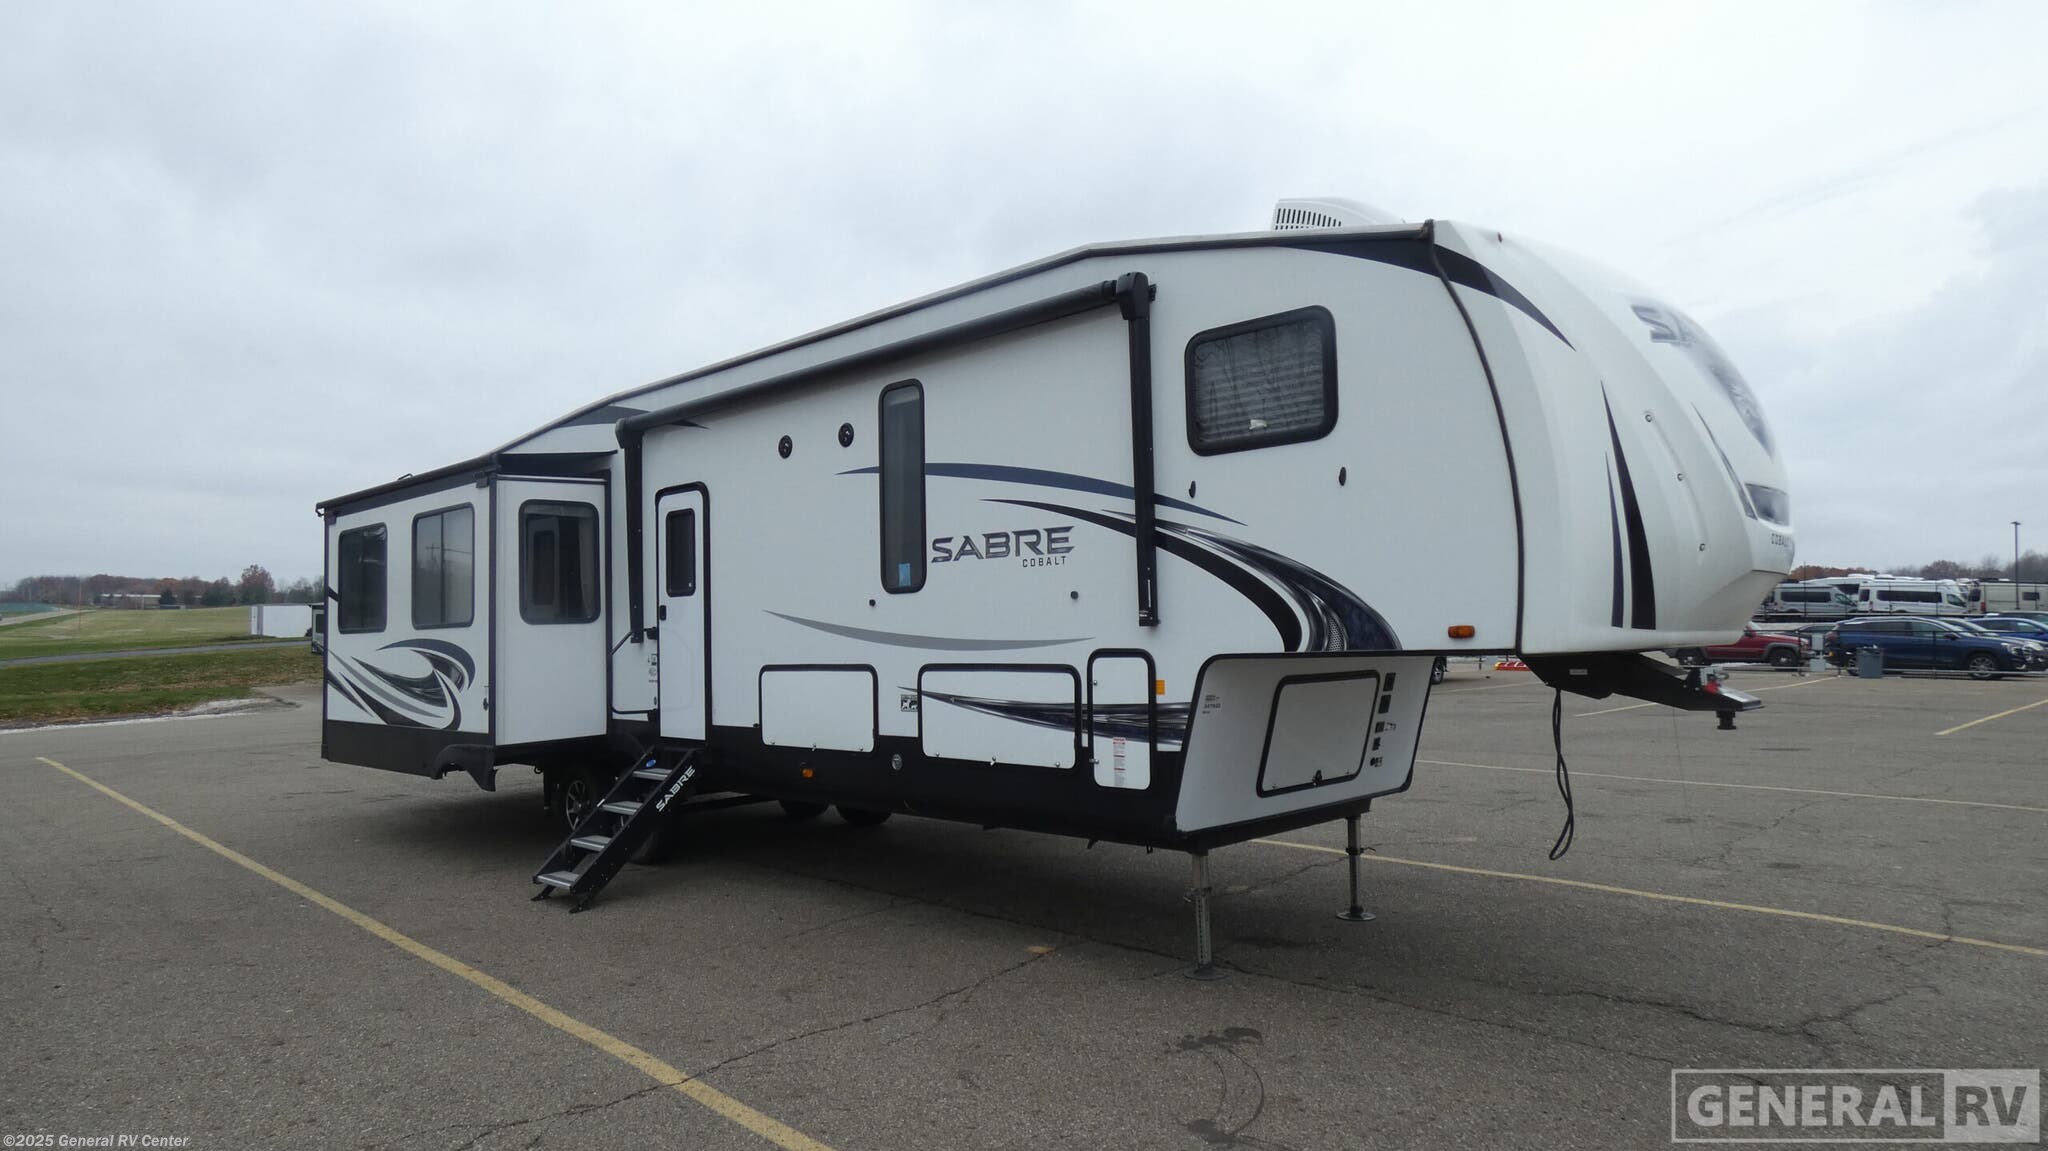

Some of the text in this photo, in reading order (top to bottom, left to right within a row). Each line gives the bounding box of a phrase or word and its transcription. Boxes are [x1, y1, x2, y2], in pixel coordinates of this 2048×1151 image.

[931, 526, 1075, 563] SABRE
[1022, 556, 1066, 568] COBALT
[656, 765, 695, 812] SABRE
